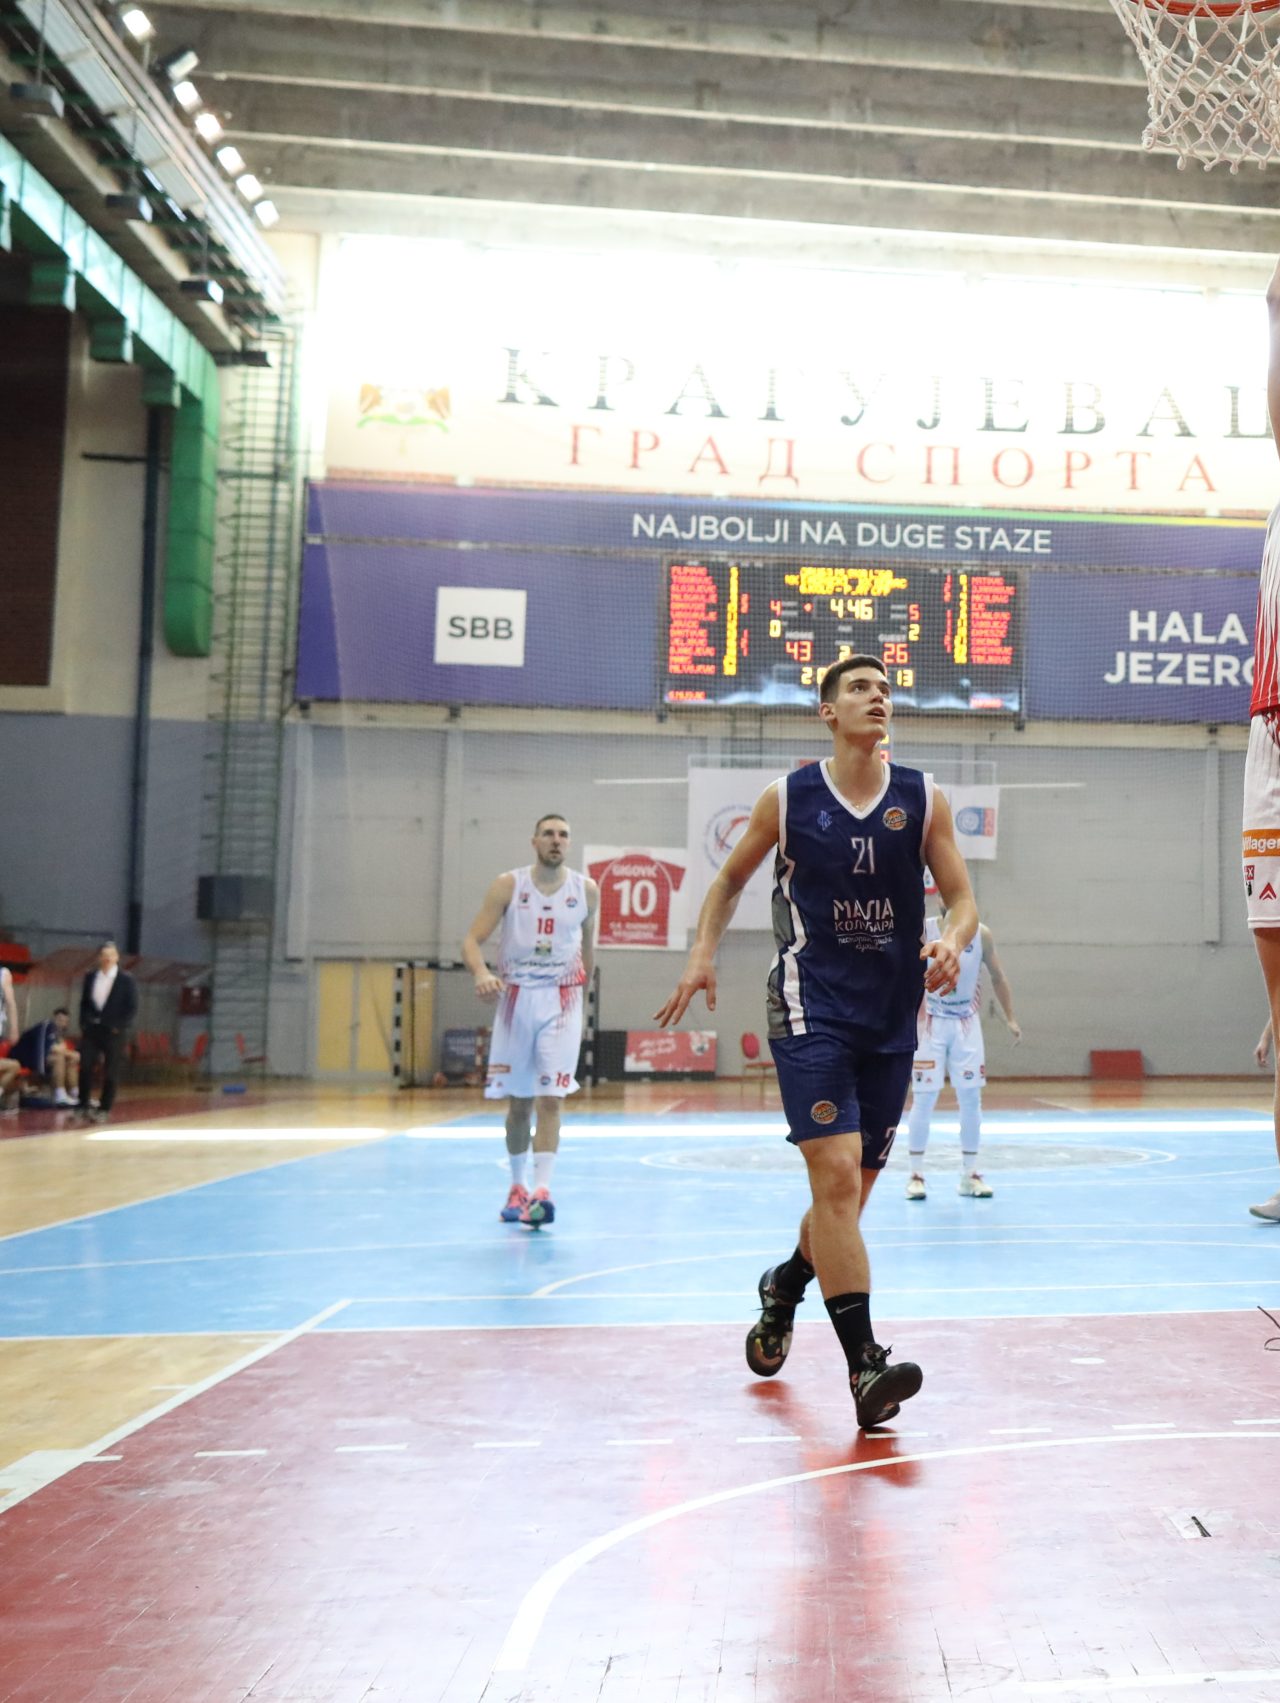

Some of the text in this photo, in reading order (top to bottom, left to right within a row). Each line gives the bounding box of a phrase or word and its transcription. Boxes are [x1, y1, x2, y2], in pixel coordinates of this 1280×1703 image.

[568, 423, 1218, 493] ГРАД СПОРТА
[632, 513, 1052, 554] NAJBOLJI NA DUGE STAZE
[448, 616, 513, 639] SBB
[1129, 610, 1249, 645] HALA
[785, 641, 811, 661] 43
[883, 643, 909, 664] 26
[850, 836, 875, 874] 21
[613, 879, 657, 917] 10
[833, 897, 894, 920] МАЛА
[537, 918, 554, 935] 18
